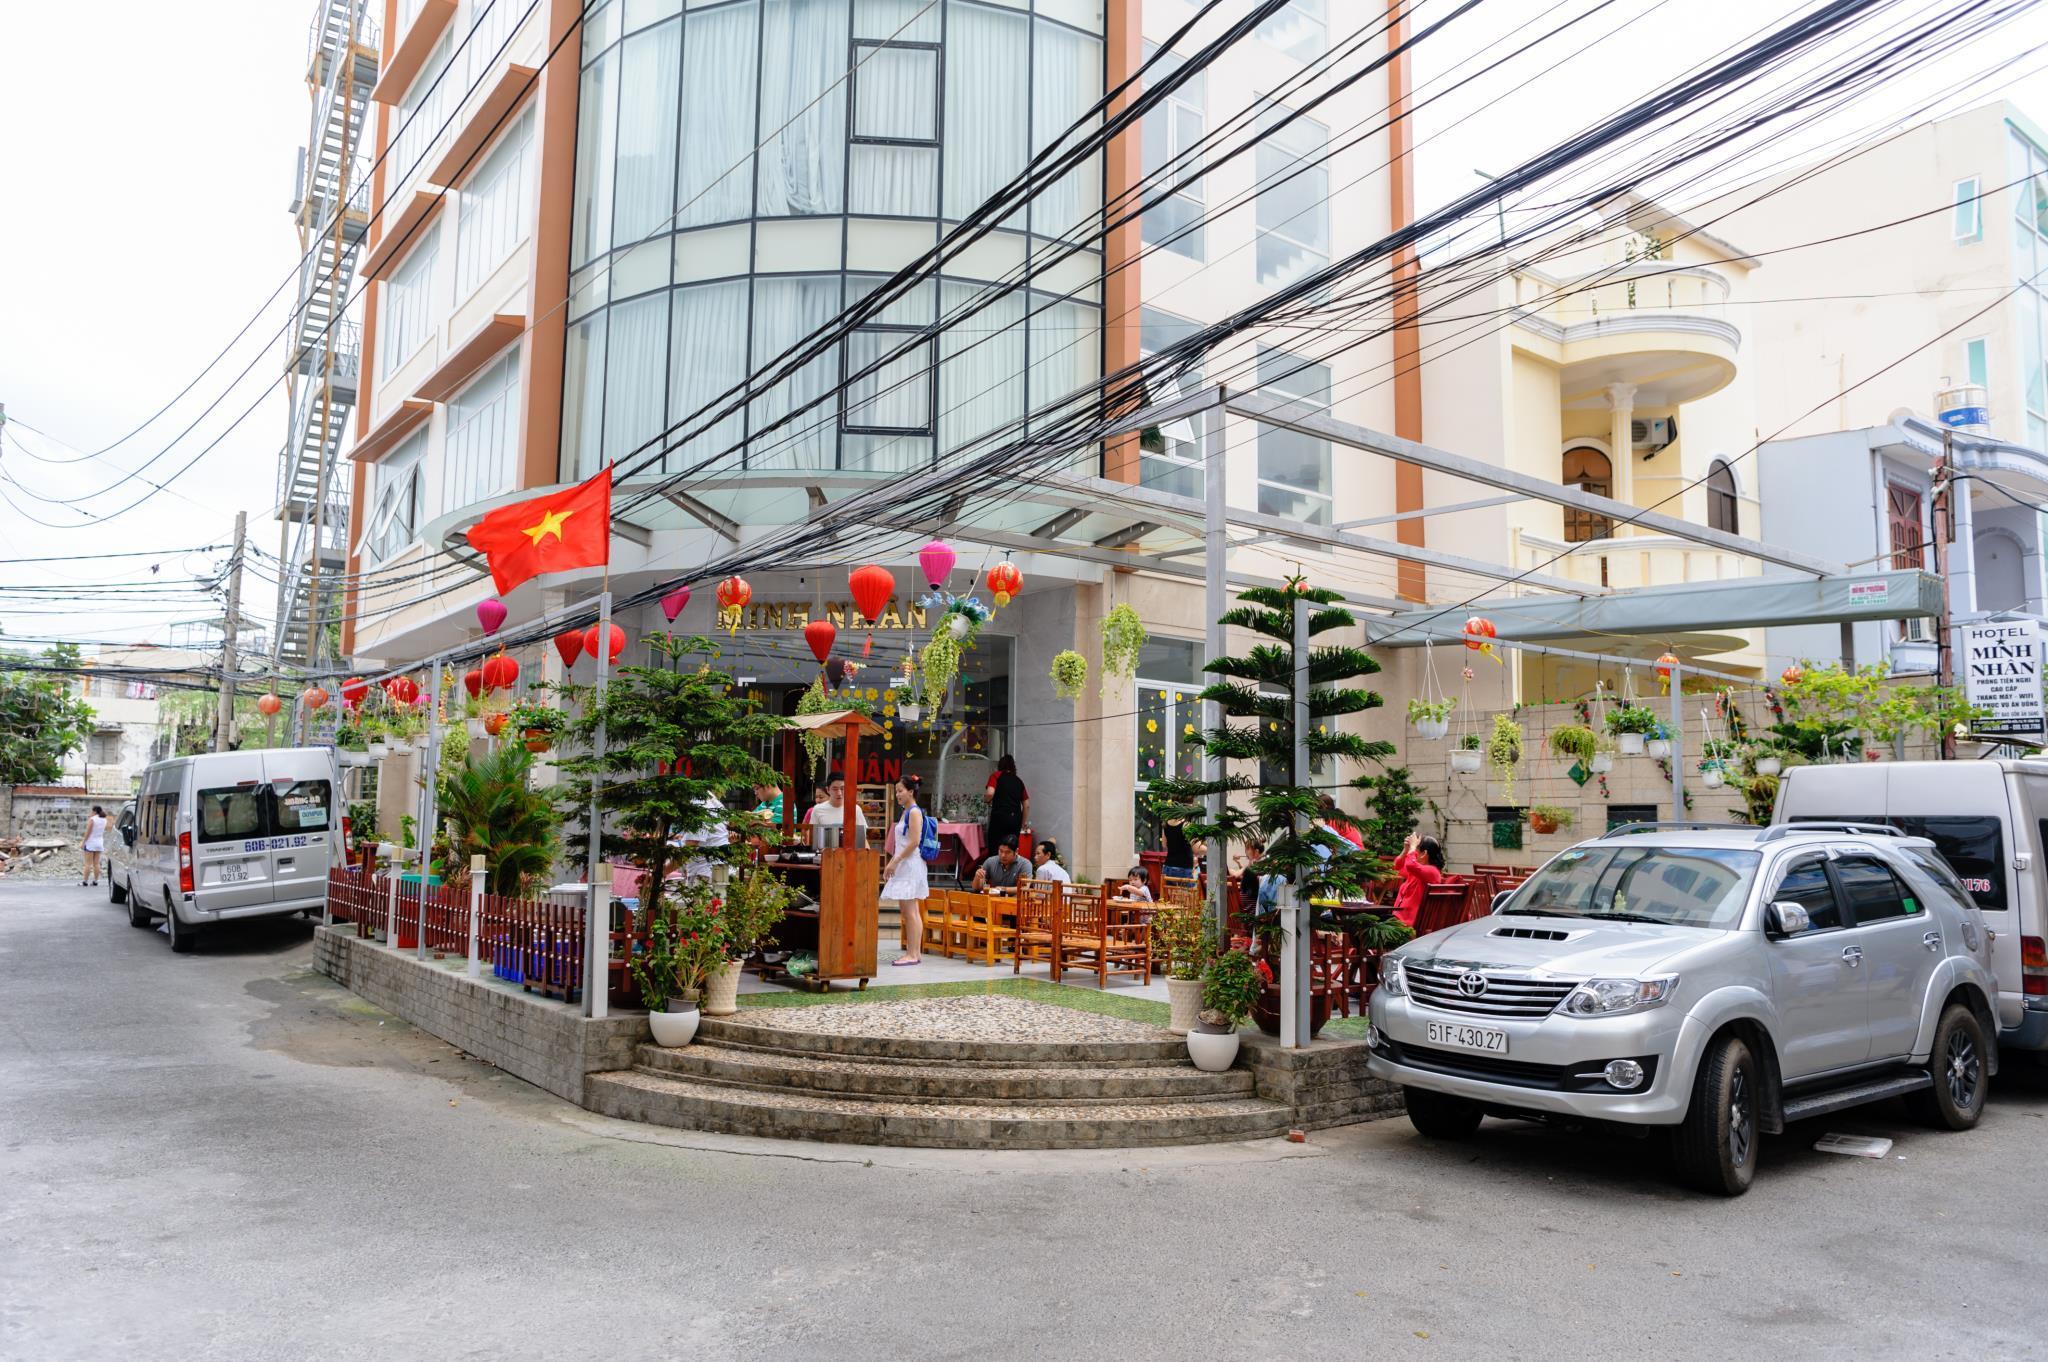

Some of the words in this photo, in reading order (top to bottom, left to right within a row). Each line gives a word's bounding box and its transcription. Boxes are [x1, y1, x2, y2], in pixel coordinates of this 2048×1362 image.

[715, 601, 812, 630] MINH
[1972, 627, 2029, 639] HOTEL
[1972, 644, 2032, 660] MINH
[1971, 659, 2035, 677] NHÂN
[831, 752, 901, 782] NÂN
[244, 836, 307, 852] 60B-021.92
[226, 864, 242, 873] 60B
[1429, 1023, 1503, 1050] 51F-430.27
